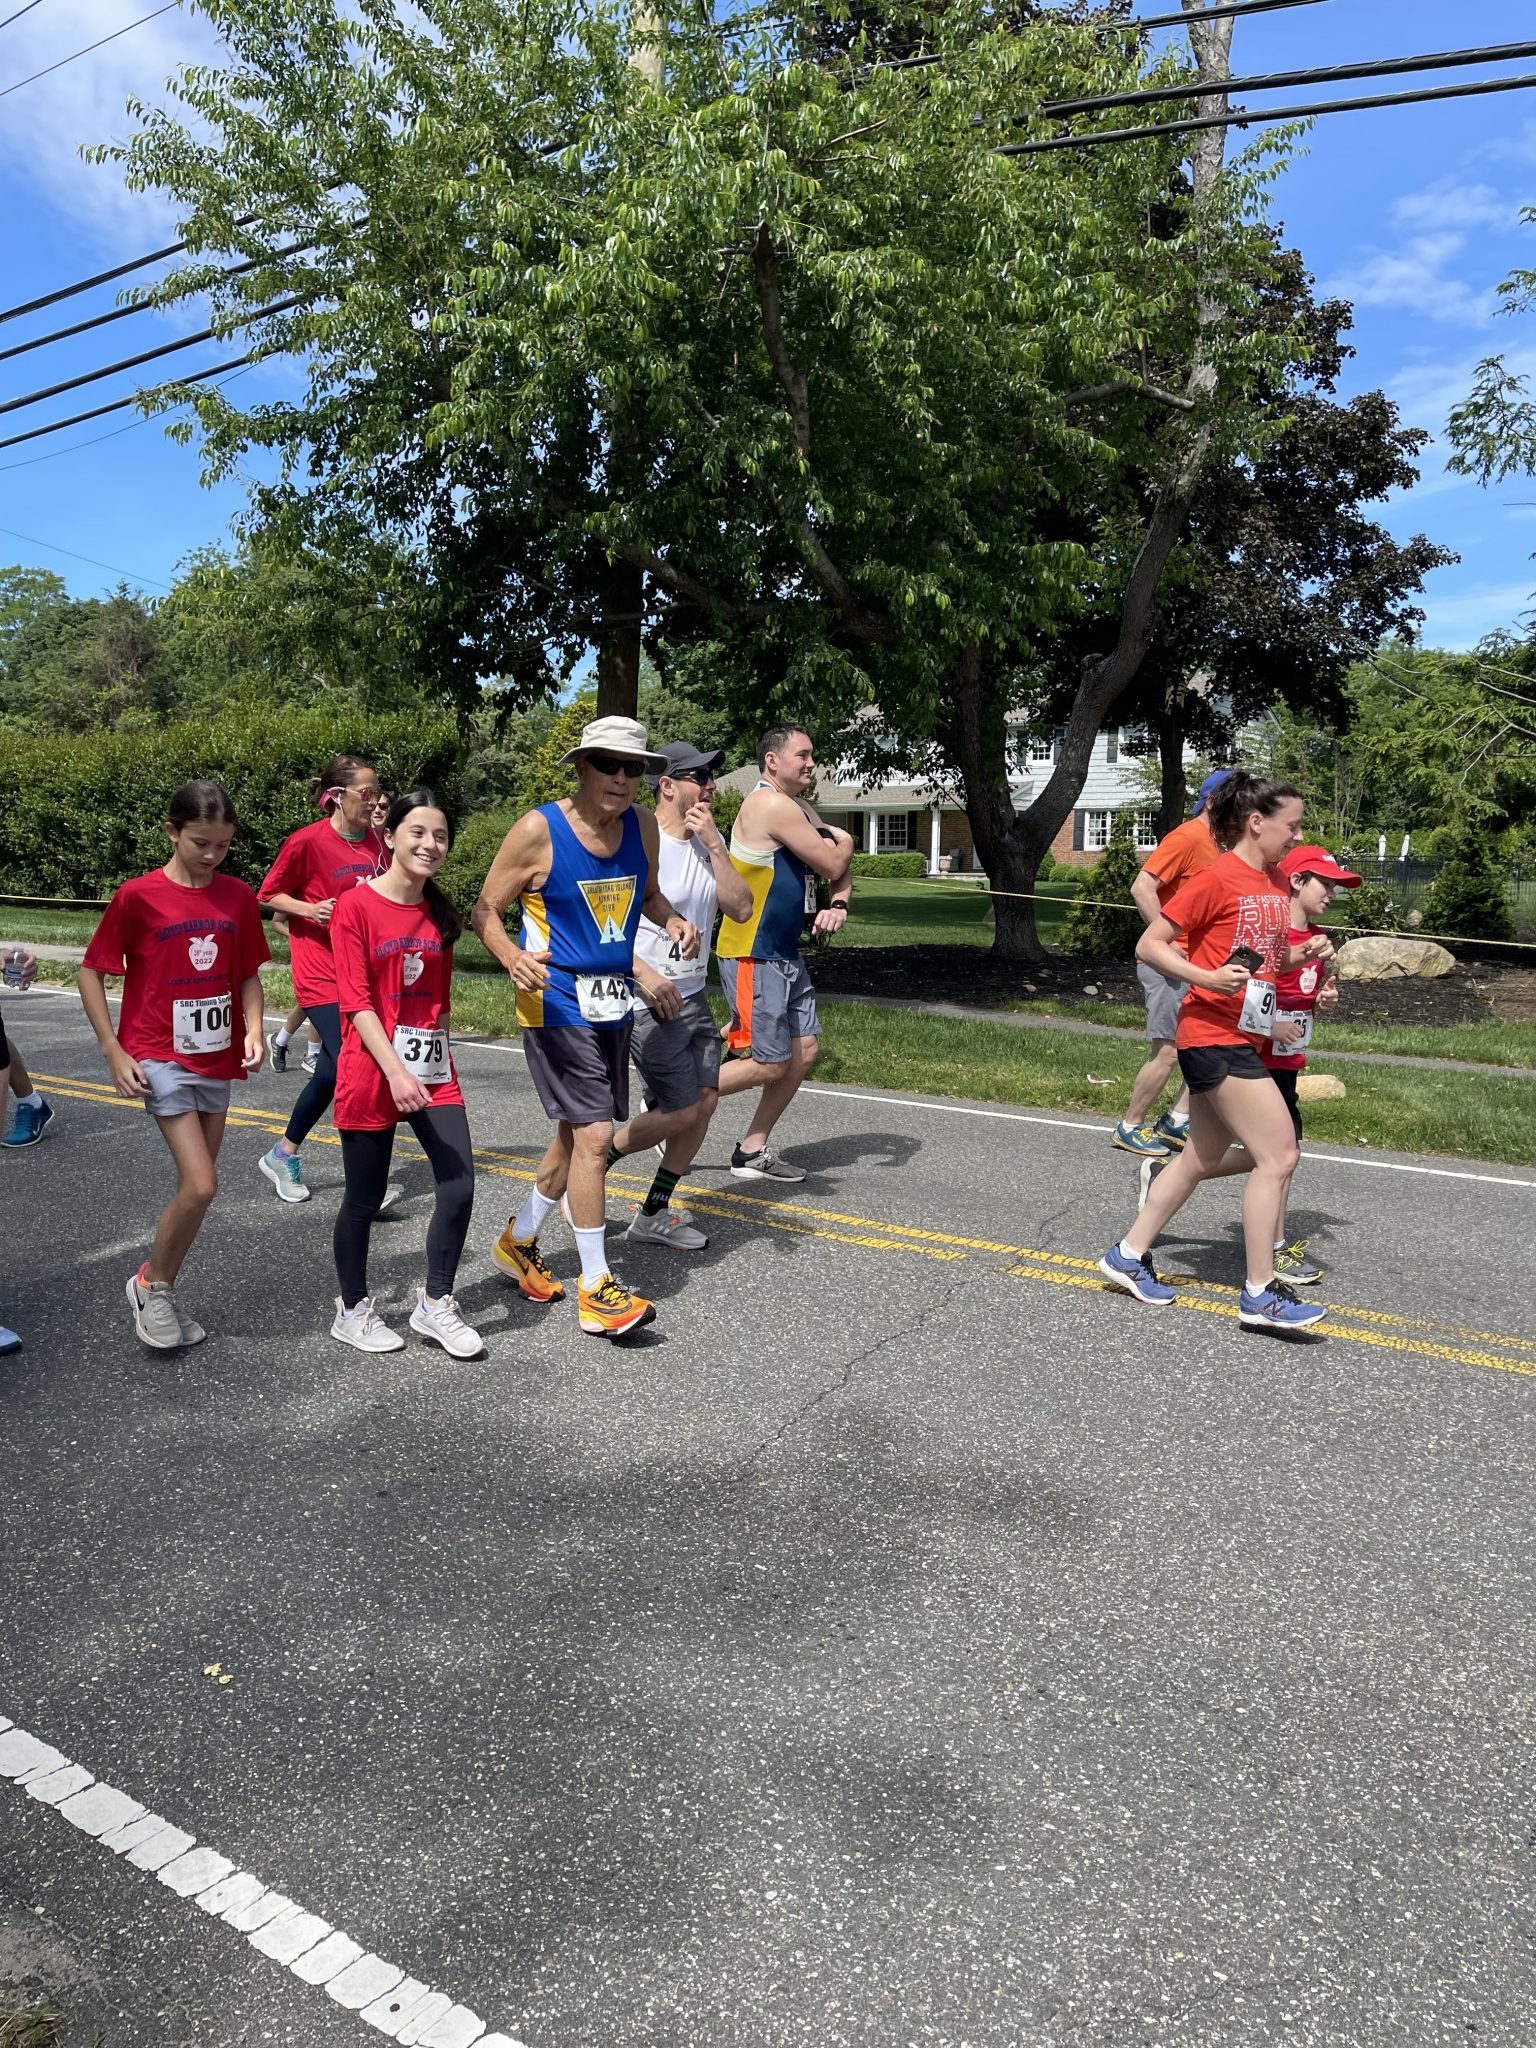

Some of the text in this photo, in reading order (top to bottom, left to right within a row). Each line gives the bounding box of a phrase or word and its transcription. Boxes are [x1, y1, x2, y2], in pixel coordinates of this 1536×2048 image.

[1238, 896, 1257, 906] THE
[1233, 938, 1250, 946] THE
[591, 979, 627, 1001] 442
[180, 1000, 194, 1008] SRC
[196, 999, 217, 1007] Timing
[190, 1004, 232, 1033] 100
[404, 1038, 442, 1063] 379
